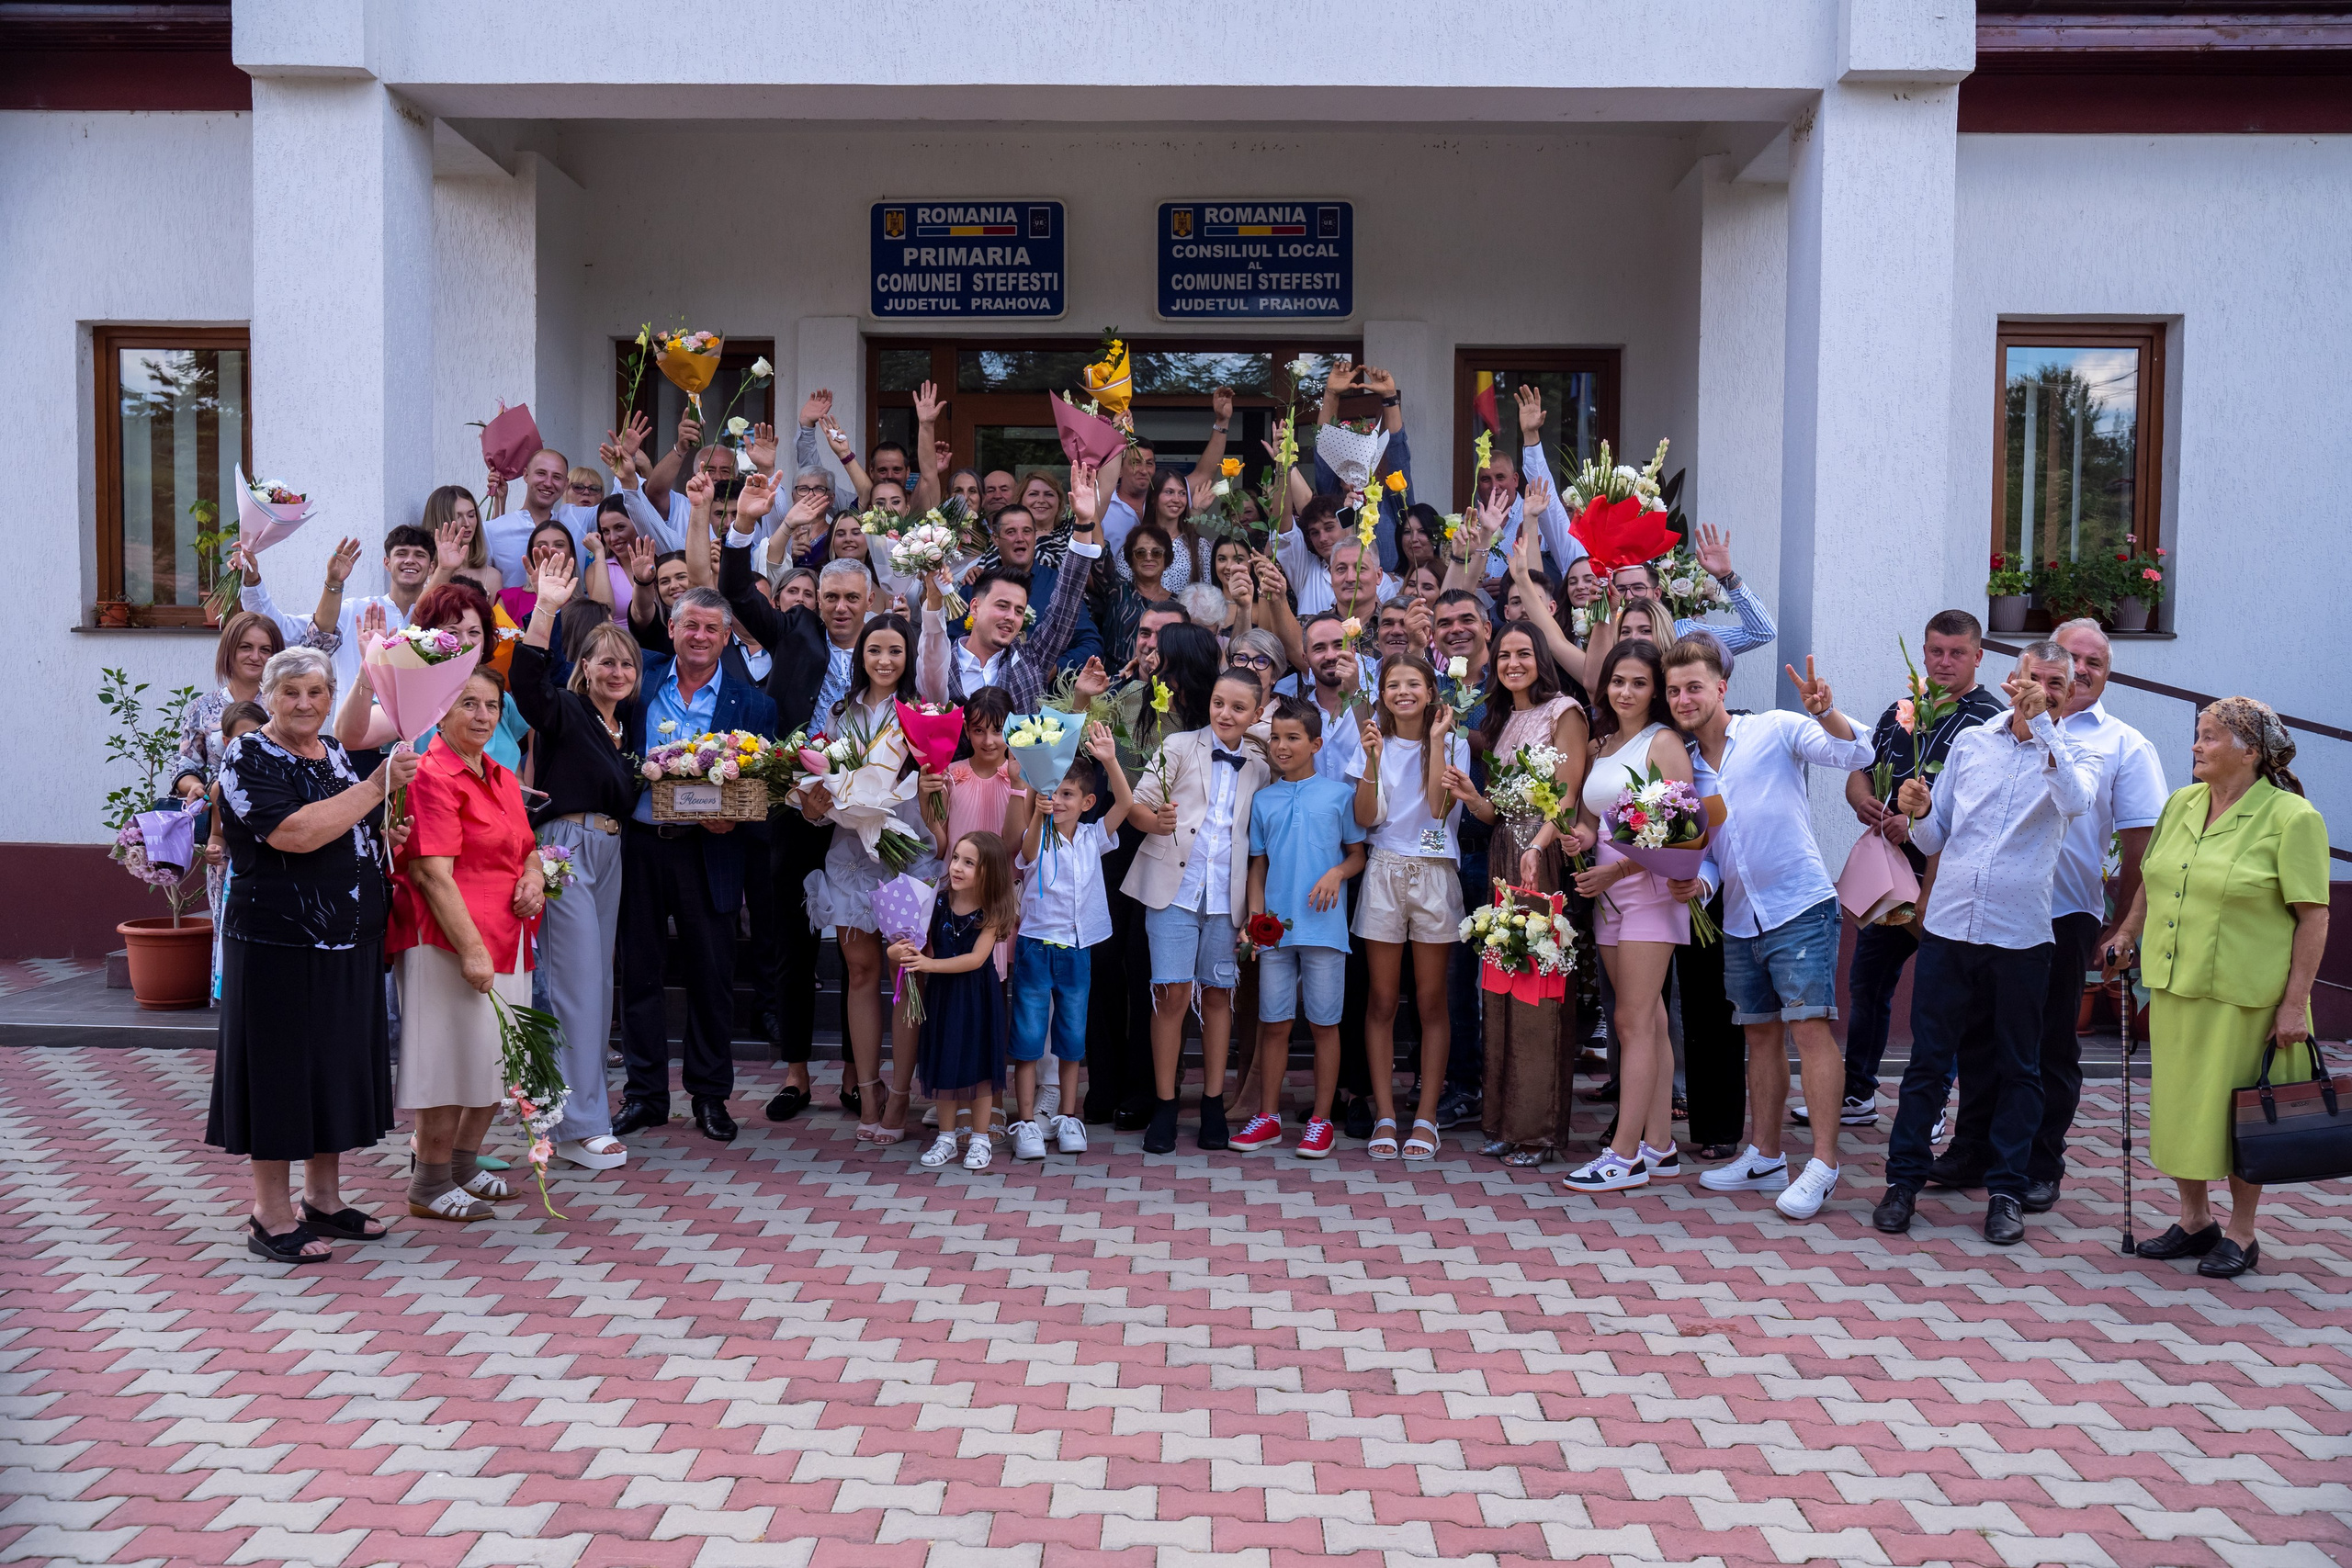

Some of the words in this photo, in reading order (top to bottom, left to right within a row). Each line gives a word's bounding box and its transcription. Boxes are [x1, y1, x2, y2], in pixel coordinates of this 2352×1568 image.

[917, 207, 1018, 223] ROMANIA
[1204, 207, 1306, 223] ROMANIA
[903, 246, 1032, 266] PRIMARIA
[1172, 244, 1272, 258] CONSILIUL
[1278, 243, 1340, 257] LOCAL
[1248, 261, 1262, 270] AL
[876, 273, 961, 292] COMUNEI
[972, 272, 1058, 292] STEFESTI
[1171, 273, 1252, 290] COMUNEI
[1258, 272, 1340, 290] STEFESTI
[883, 298, 961, 310] JUDETUL
[971, 297, 1051, 310] PRAHOVA
[1170, 298, 1250, 311] JUDETUL
[1259, 297, 1340, 310] PRAHOVA
[680, 792, 717, 805] Flowers
